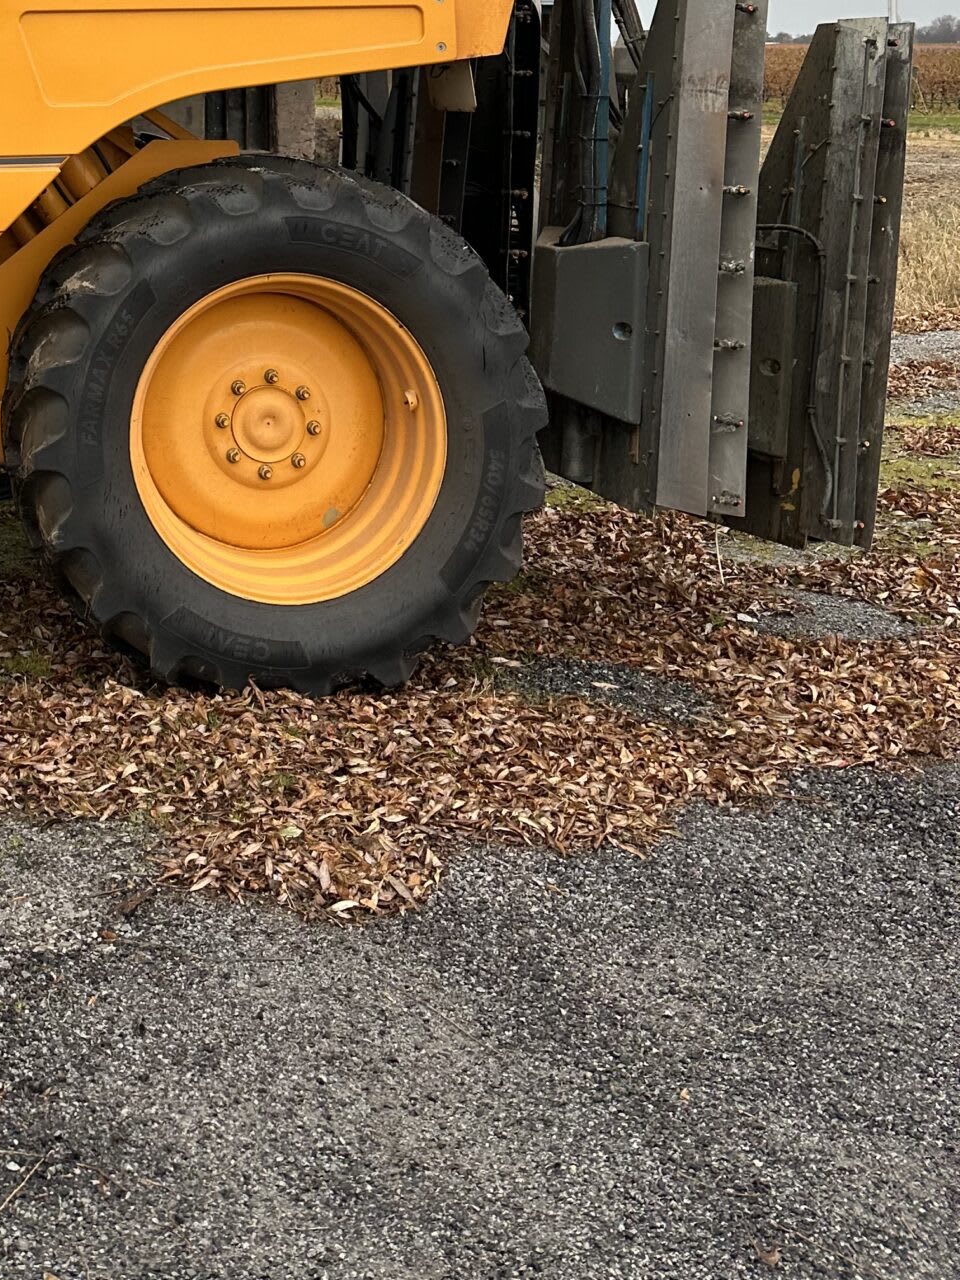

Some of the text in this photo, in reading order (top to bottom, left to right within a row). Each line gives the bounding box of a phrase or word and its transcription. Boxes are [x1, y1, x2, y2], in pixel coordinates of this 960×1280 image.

[320, 224, 387, 259] CEAT
[81, 345, 115, 446] FARMAX
[465, 446, 505, 552] 540/65R34
